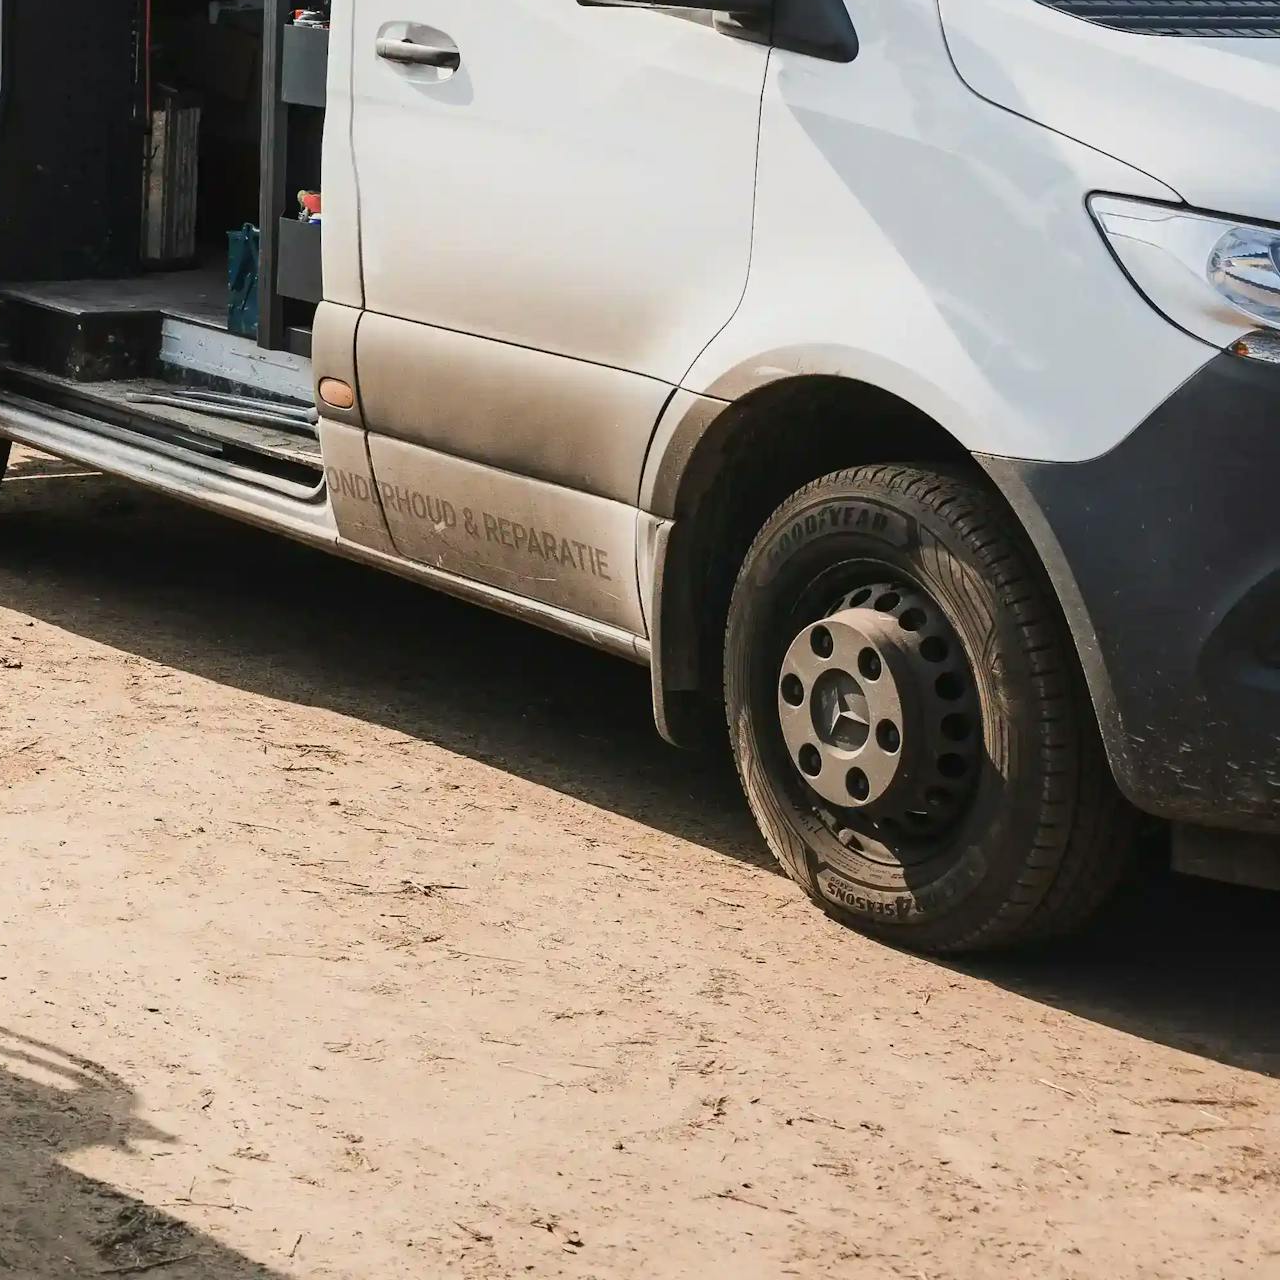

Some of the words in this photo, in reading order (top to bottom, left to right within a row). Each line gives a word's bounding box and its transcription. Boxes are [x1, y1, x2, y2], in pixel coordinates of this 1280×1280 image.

[462, 507, 480, 538] &
[483, 512, 612, 581] REPARATIE
[767, 505, 889, 563] GOODYEAR
